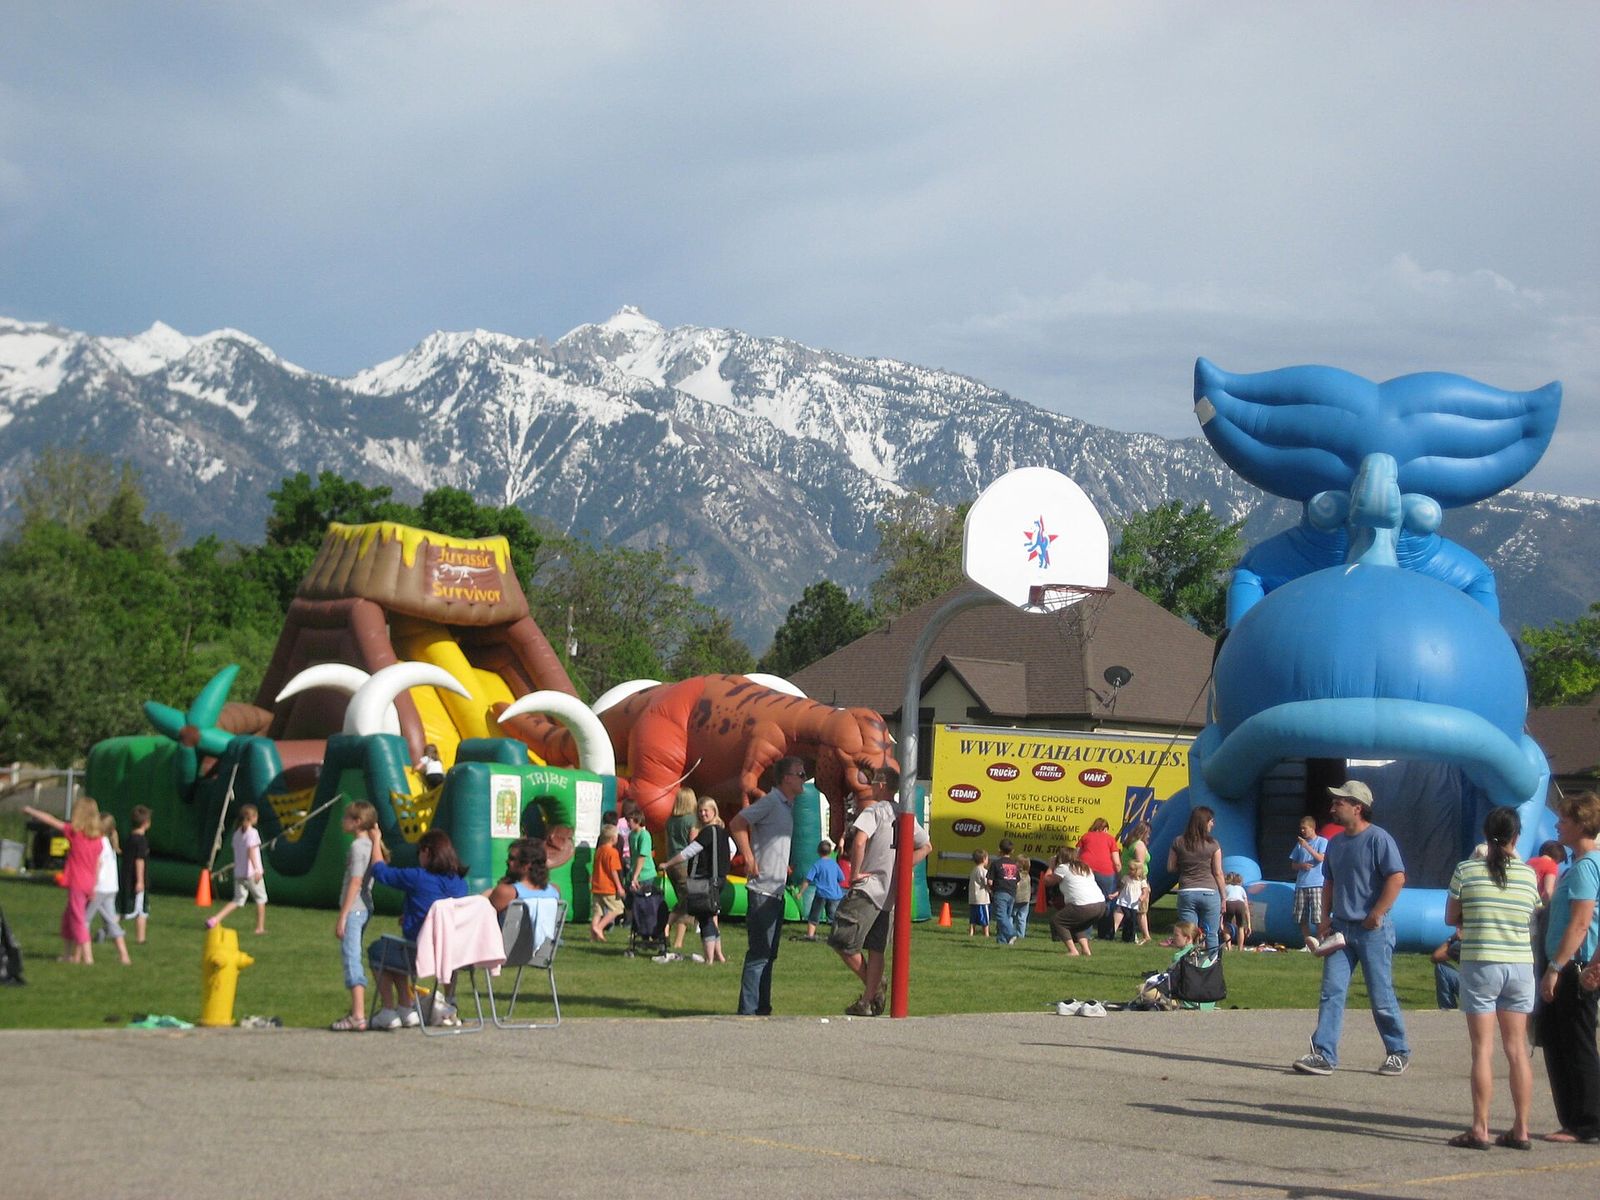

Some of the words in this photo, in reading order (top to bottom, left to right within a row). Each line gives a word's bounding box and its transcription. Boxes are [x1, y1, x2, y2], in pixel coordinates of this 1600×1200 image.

[431, 582, 501, 602] Survivor
[989, 767, 1018, 778] TRUCKS
[1083, 772, 1107, 782] VANS
[526, 771, 569, 790] TRIBE
[950, 789, 978, 799] SEDANS
[1029, 793, 1040, 802] TO
[1041, 795, 1076, 804] CHOOSE
[1077, 797, 1101, 805] FROM
[1055, 806, 1085, 814] PRICES
[1005, 812, 1043, 821] UPDATED
[1044, 814, 1068, 822] DAILY
[955, 823, 981, 833] COUPES
[1005, 821, 1032, 830] TRADE
